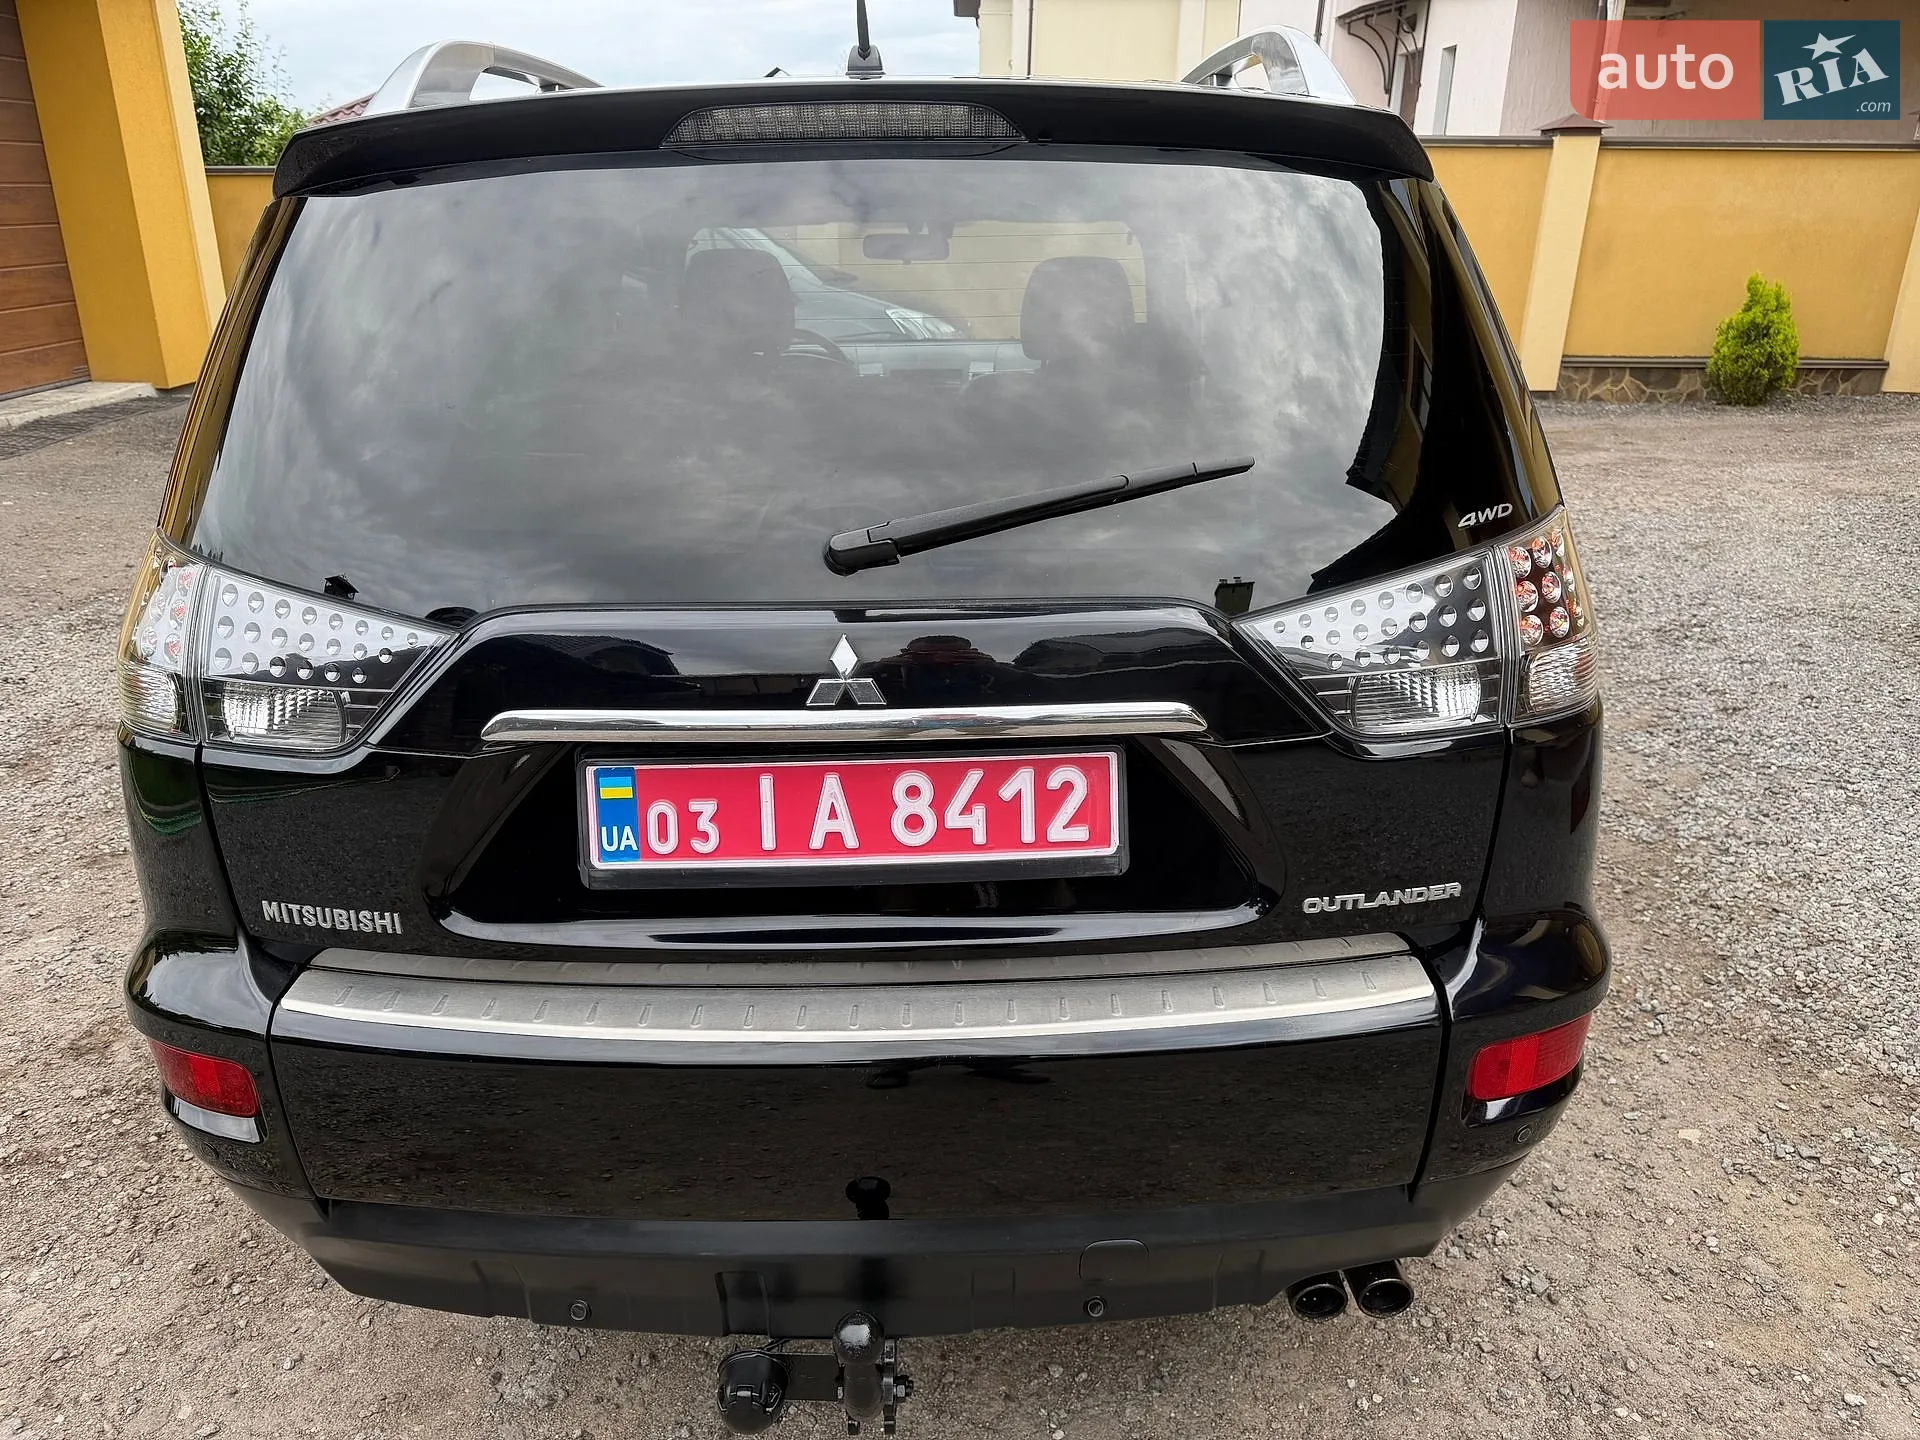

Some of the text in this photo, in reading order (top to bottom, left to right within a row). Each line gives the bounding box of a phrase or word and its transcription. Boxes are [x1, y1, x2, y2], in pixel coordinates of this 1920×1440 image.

[1457, 503, 1513, 528] 4WD
[646, 800, 720, 856] 03
[890, 765, 1090, 847] 8412
[600, 825, 638, 852] UA
[1303, 882, 1462, 914] OUTLANDER
[262, 900, 402, 935] MITSUBISHI
